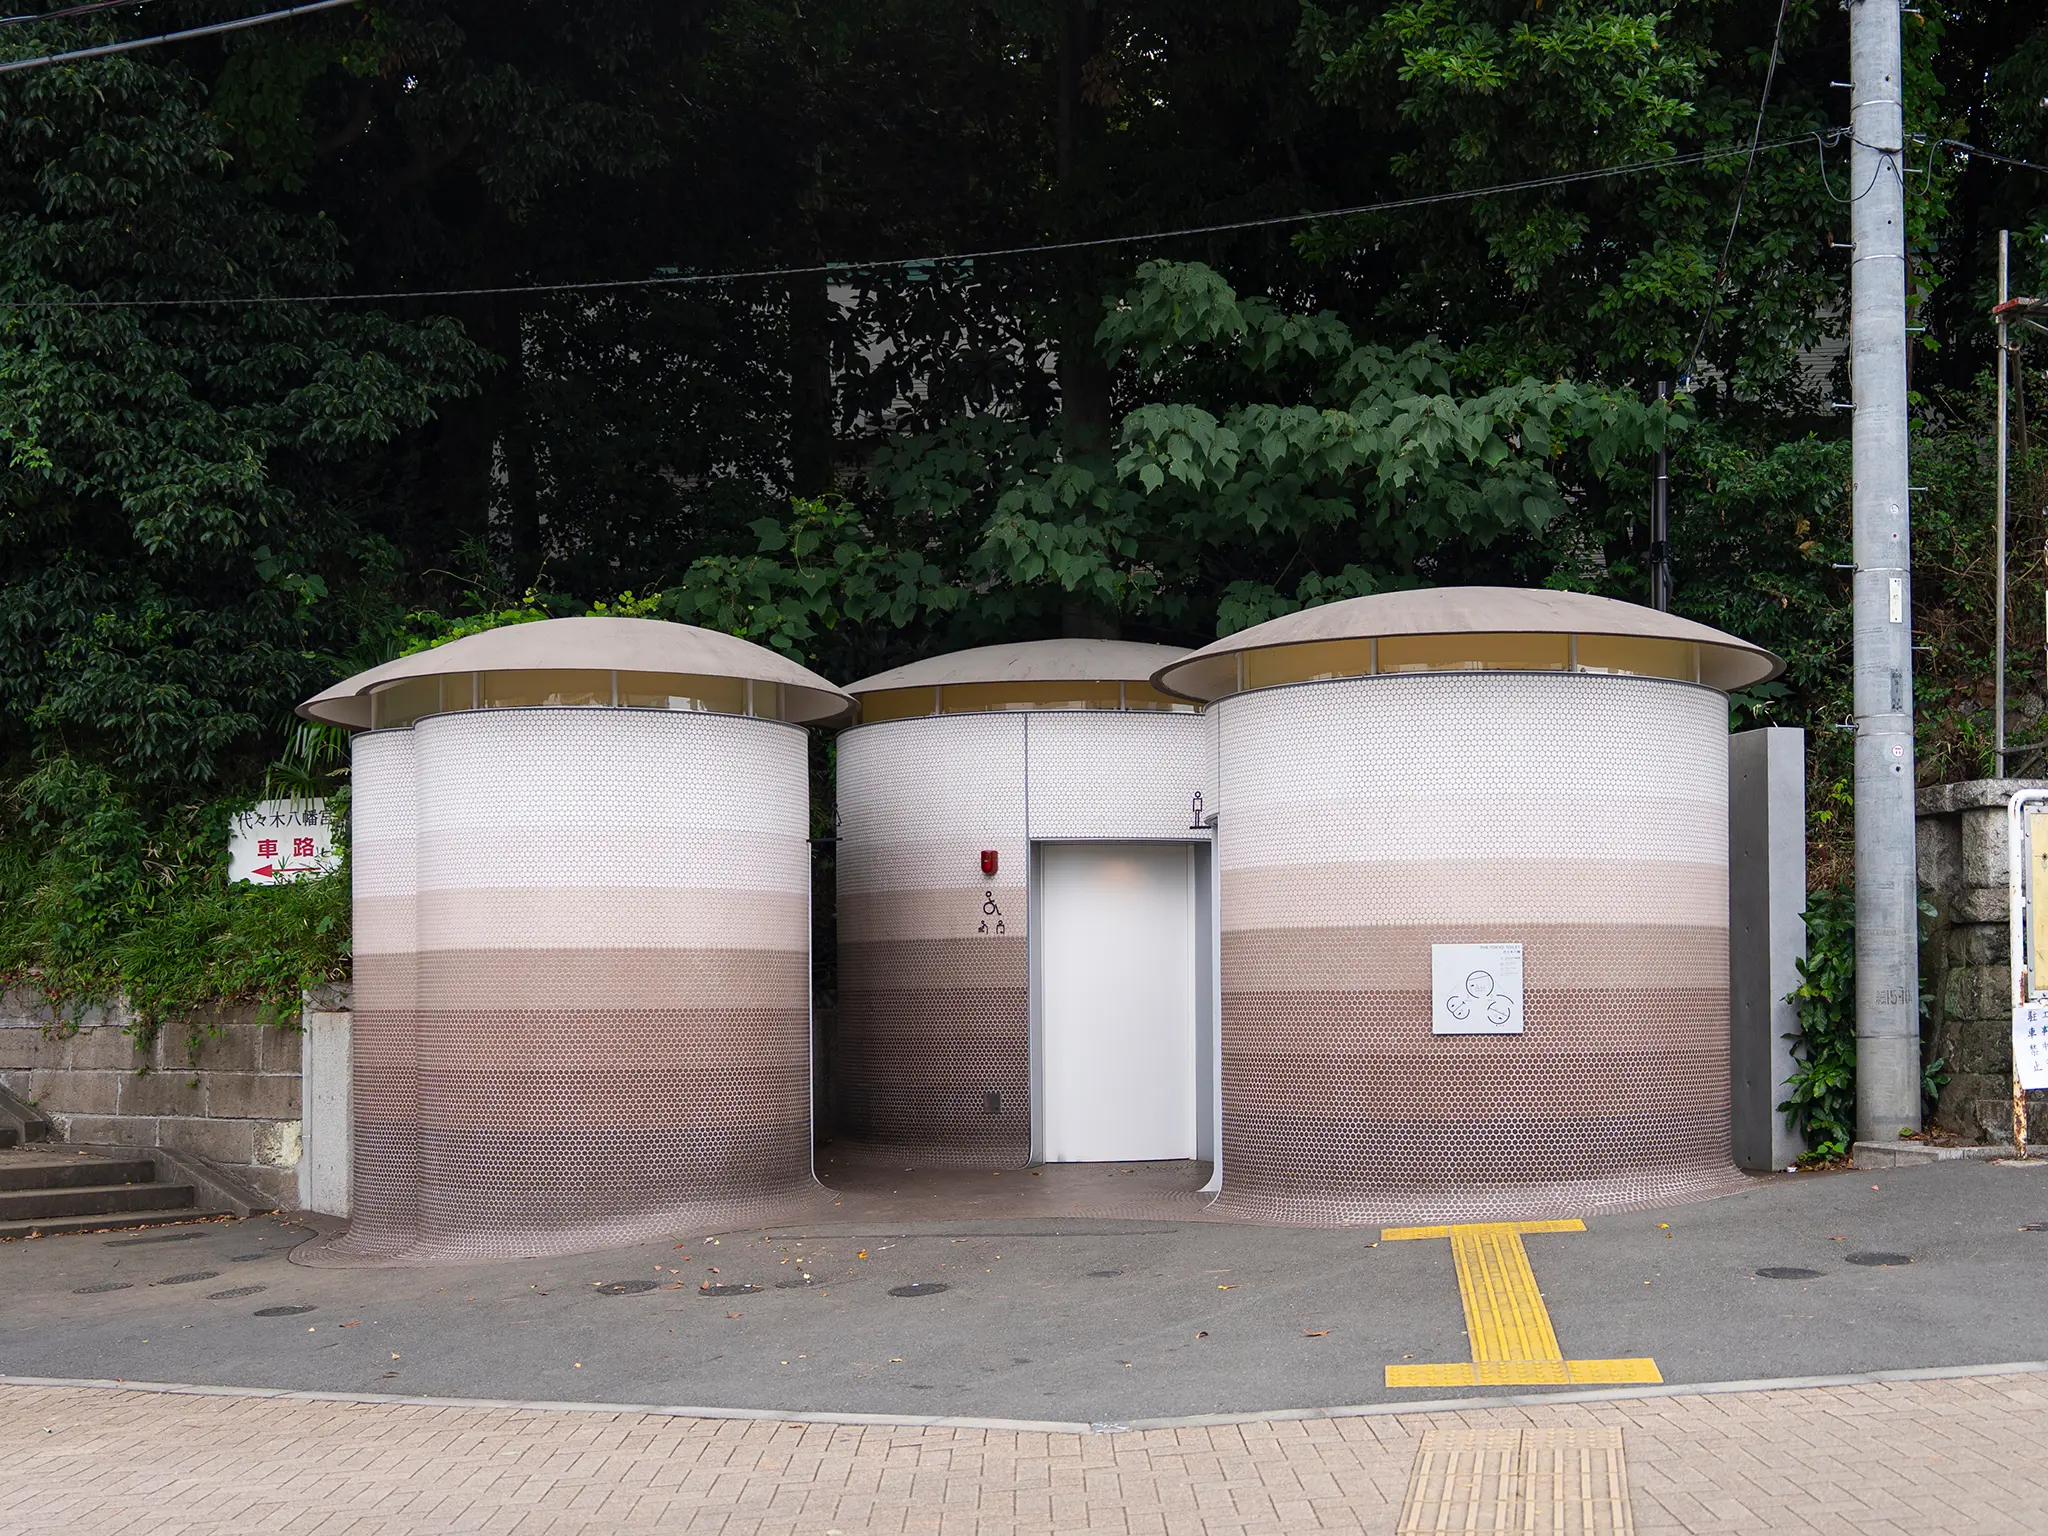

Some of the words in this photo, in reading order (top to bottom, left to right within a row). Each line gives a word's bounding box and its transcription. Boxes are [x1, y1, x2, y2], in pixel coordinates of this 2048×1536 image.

[257, 837, 314, 859] 車路
[2027, 1010, 2043, 1072] 駐車禁止
